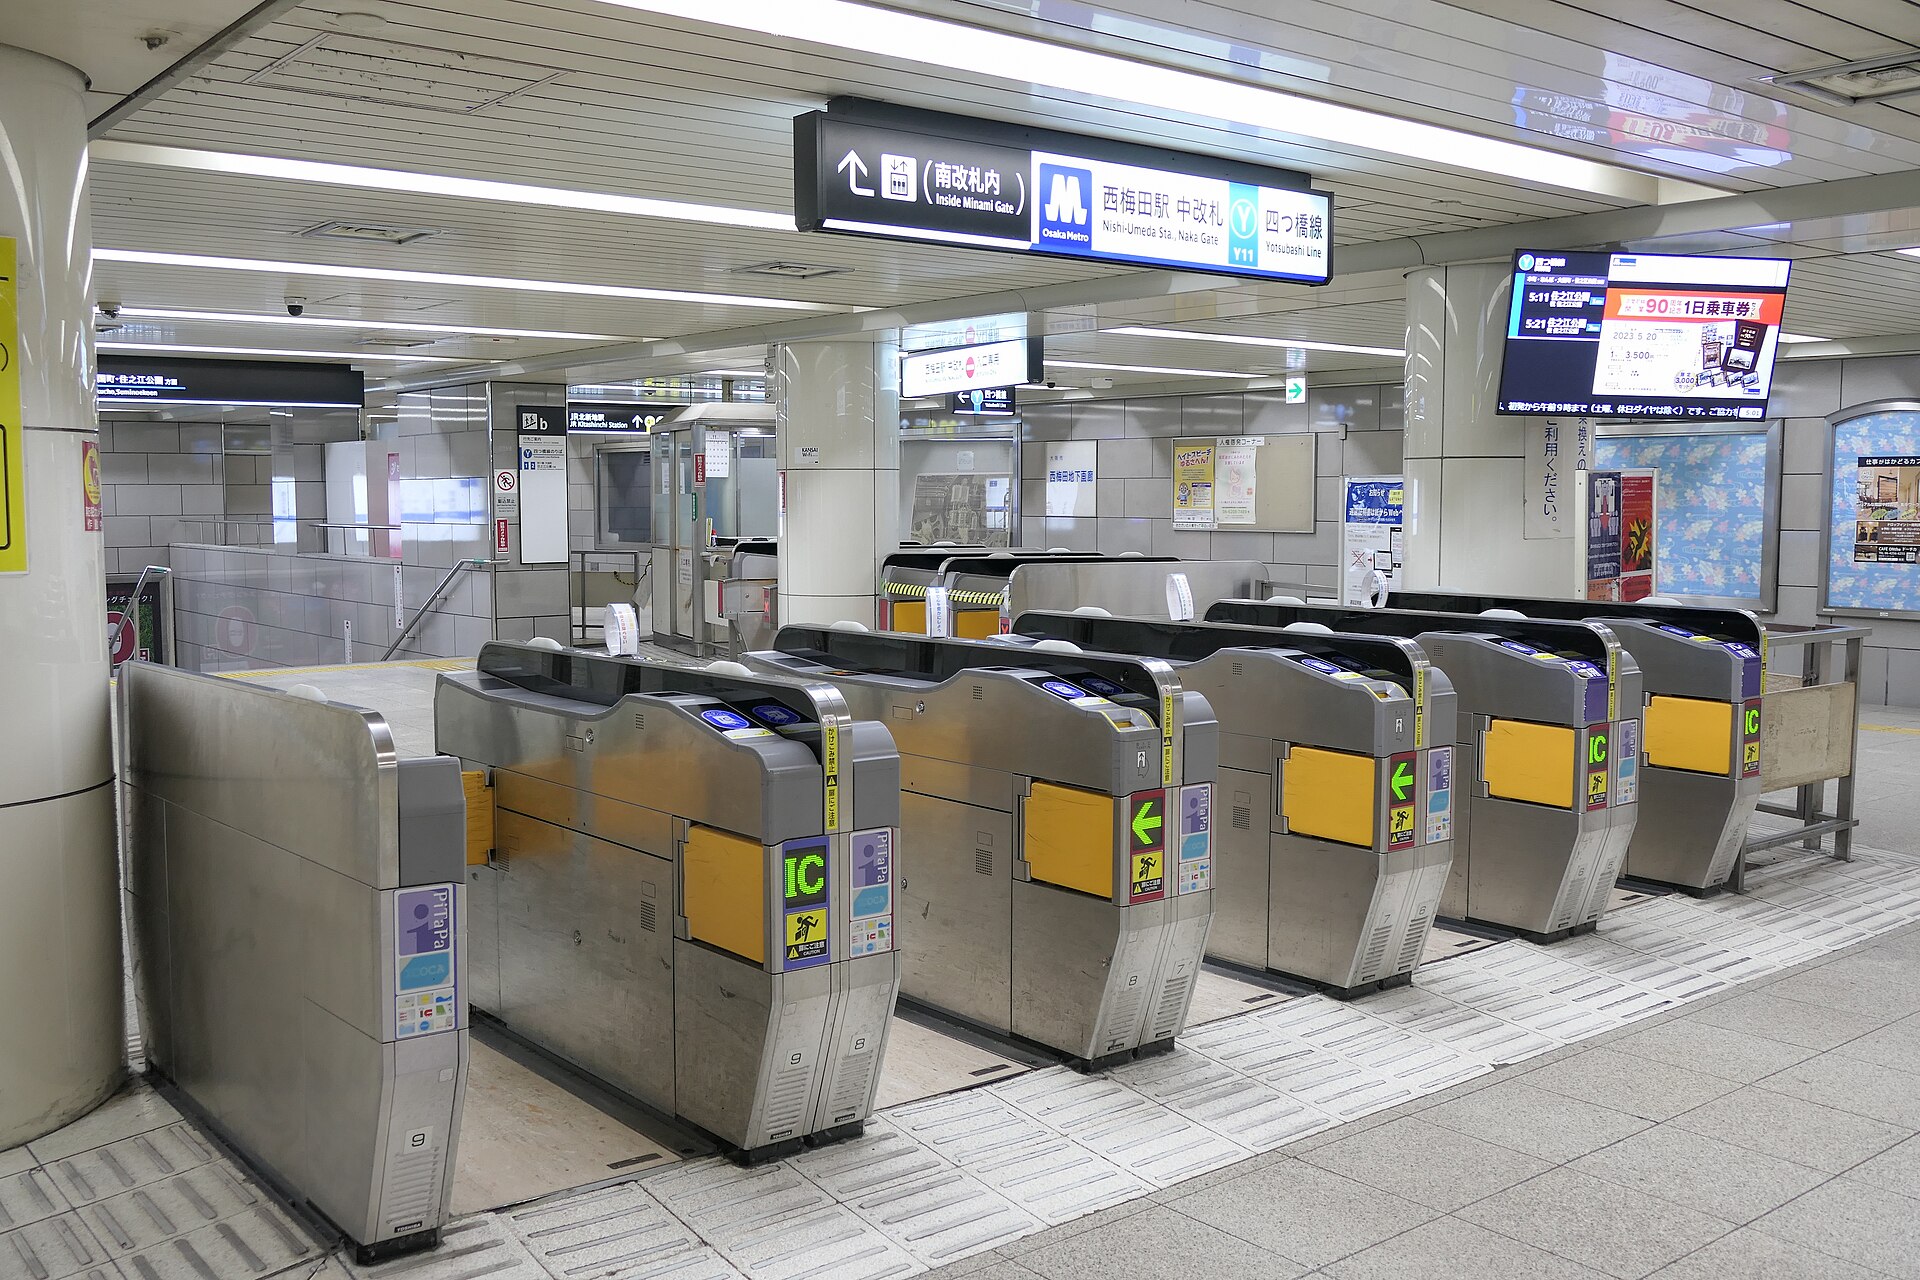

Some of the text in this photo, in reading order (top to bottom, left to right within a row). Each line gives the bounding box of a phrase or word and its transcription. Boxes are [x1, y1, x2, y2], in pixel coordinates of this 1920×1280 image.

[935, 162, 1001, 196] 南改札内
[936, 193, 1014, 215] Inside Minami Gate
[1103, 185, 1224, 227] 西梅田駅 中改札
[1237, 205, 1251, 233] Y
[1266, 209, 1323, 240] 四つ橋線
[1042, 228, 1089, 242] Osaka Metro
[1102, 219, 1157, 238] Nishi-Umeda
[1178, 230, 1198, 242] Naka
[1200, 233, 1219, 246] Gate
[1233, 247, 1254, 262] Y11
[1265, 240, 1322, 258] Yotsubashi Line
[1528, 292, 1550, 302] 5:11
[1551, 290, 1591, 302] 住之江公園
[1646, 298, 1669, 314] 90
[1684, 300, 1751, 317] 1日乗車券
[1525, 319, 1547, 329] 5:21
[1547, 317, 1588, 329] 住之江公園
[1613, 332, 1634, 340] 2023
[1646, 332, 1657, 341] 20
[540, 421, 548, 431] b
[608, 421, 628, 429] Station
[1745, 709, 1760, 735] IC
[1589, 735, 1607, 764] IC
[1200, 789, 1208, 831] PiTaPa
[877, 833, 888, 883] PiTaPa
[785, 854, 824, 898] IC
[433, 890, 448, 949] PiTaPa
[1384, 914, 1391, 923] 7
[1177, 964, 1185, 974] 7
[1129, 975, 1138, 986] 8
[854, 1038, 866, 1050] 8
[791, 1053, 802, 1065] 9
[411, 1133, 425, 1147] 9
